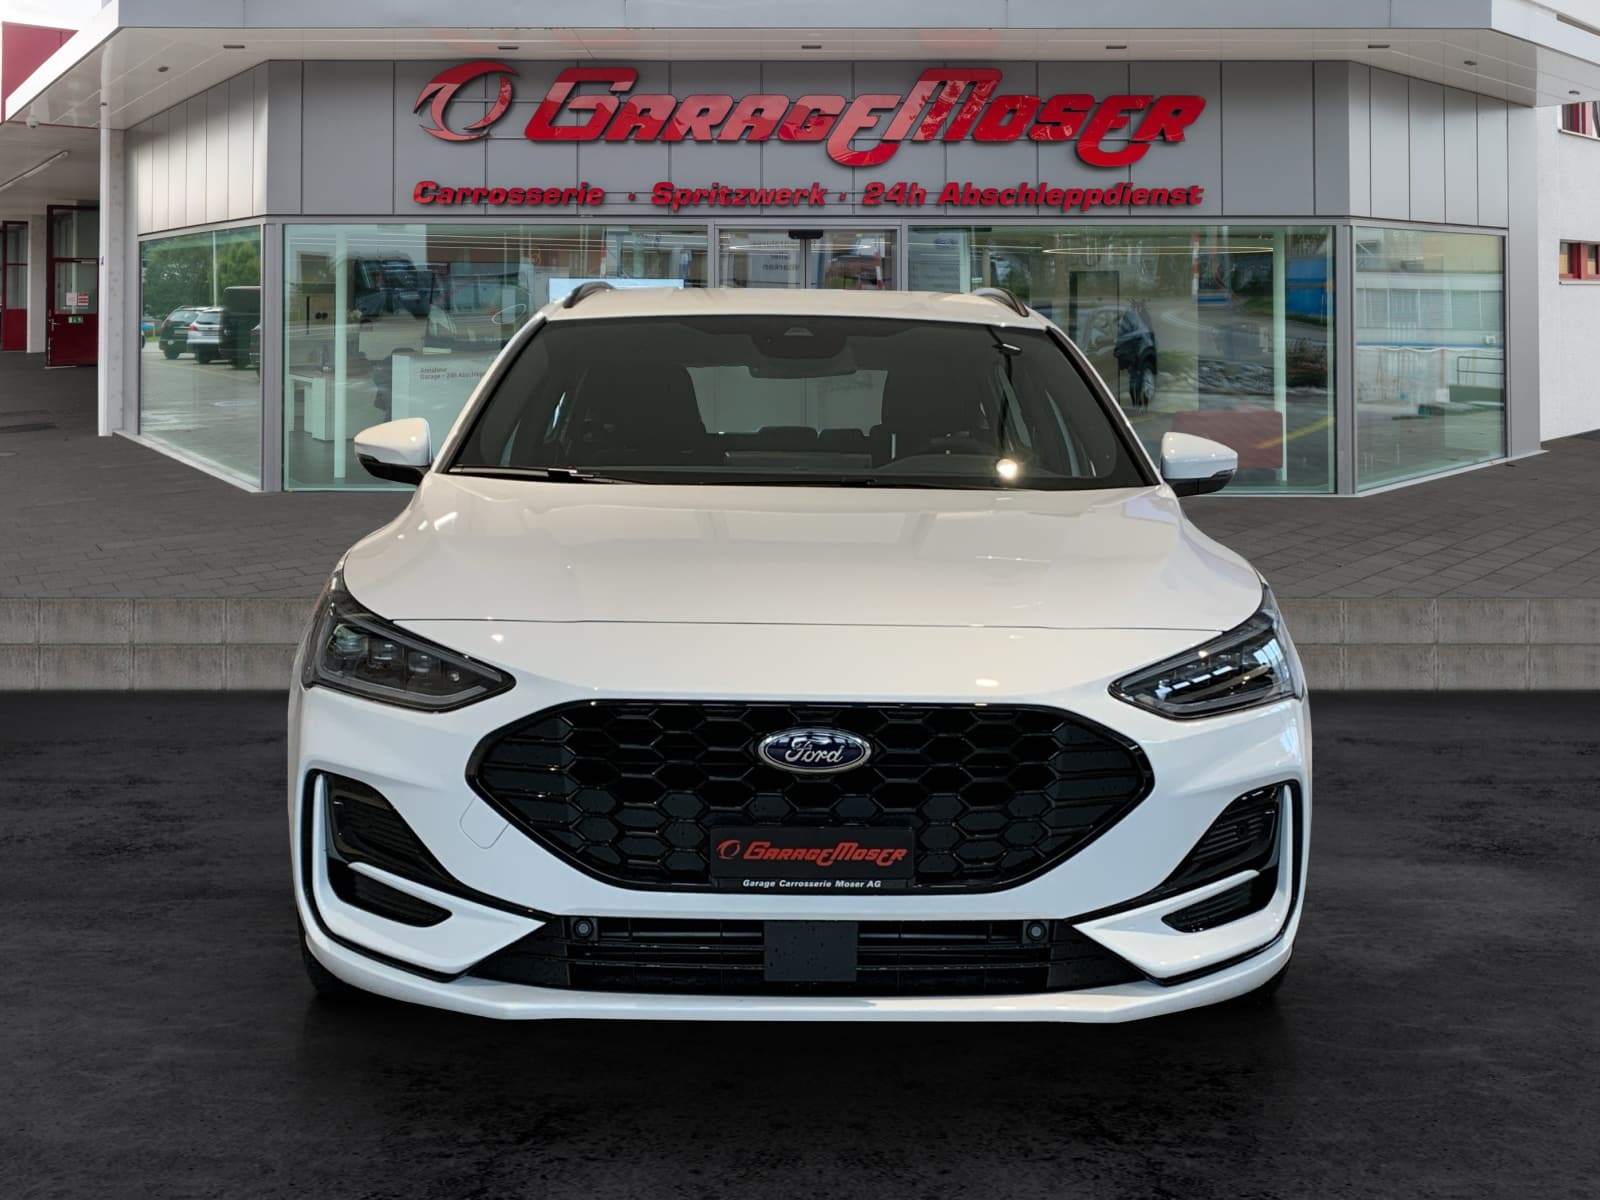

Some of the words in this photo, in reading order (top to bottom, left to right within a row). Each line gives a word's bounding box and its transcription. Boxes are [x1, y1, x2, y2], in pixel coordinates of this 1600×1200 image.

[413, 180, 606, 207] Carrosserie
[651, 182, 827, 212] Spritzwerk
[862, 182, 927, 206] 24h
[936, 182, 1205, 212] Abschleppdienst
[784, 740, 845, 763] Ford
[742, 879, 776, 888] Garage
[778, 879, 832, 888] Carrosserie
[834, 879, 865, 888] Moser
[867, 880, 882, 888] AG
